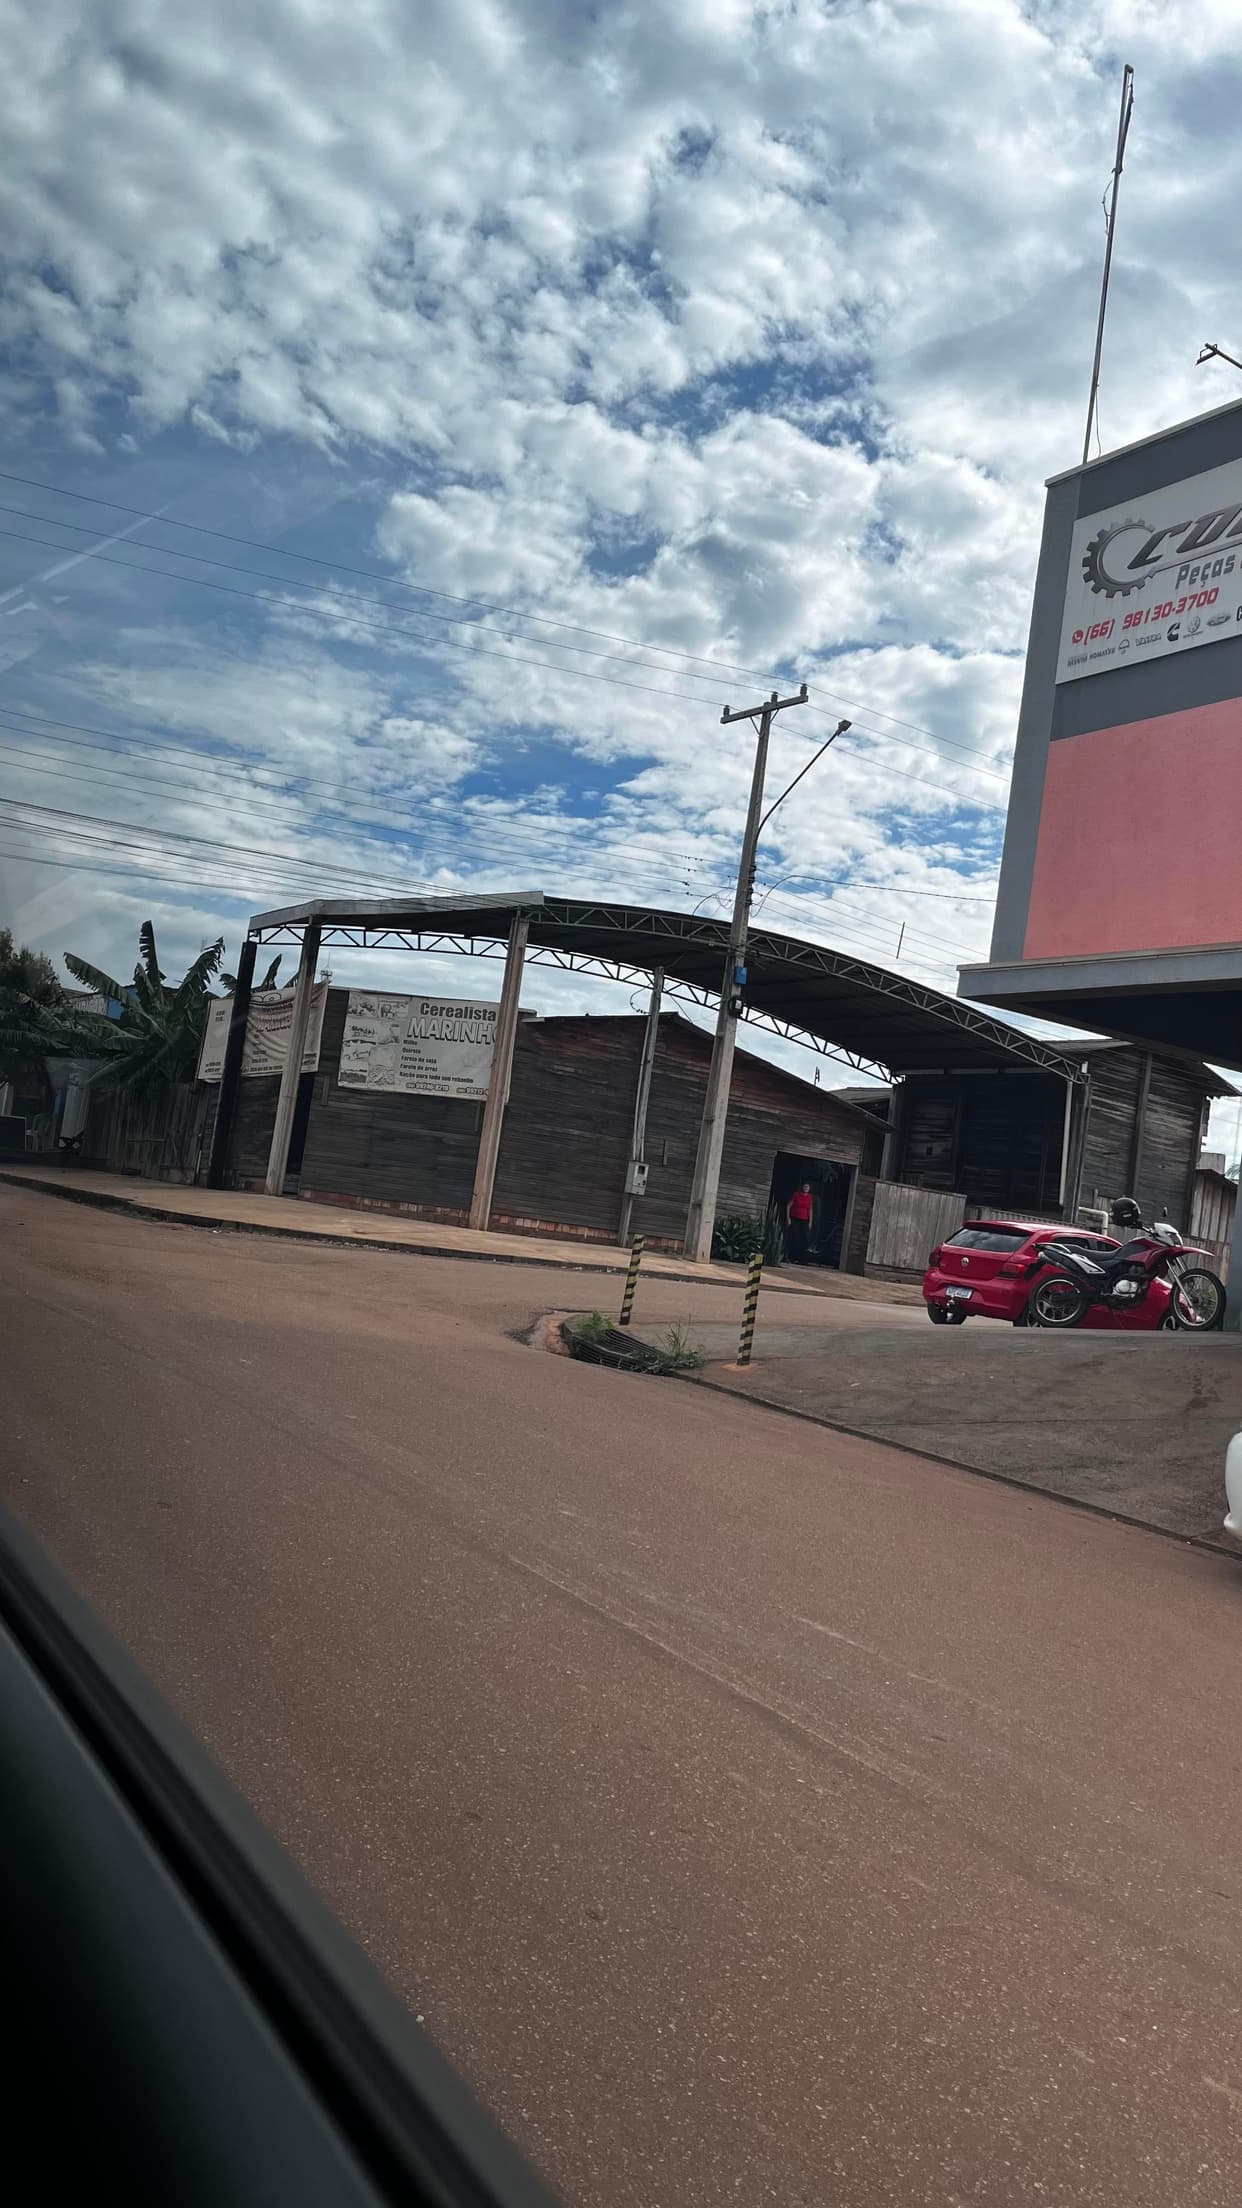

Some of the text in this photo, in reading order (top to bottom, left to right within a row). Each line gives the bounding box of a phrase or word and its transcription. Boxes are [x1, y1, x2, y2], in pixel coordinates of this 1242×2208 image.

[1175, 554, 1236, 590] Peças
[1084, 618, 1116, 646] (66)
[420, 1002, 497, 1022] Cerealista
